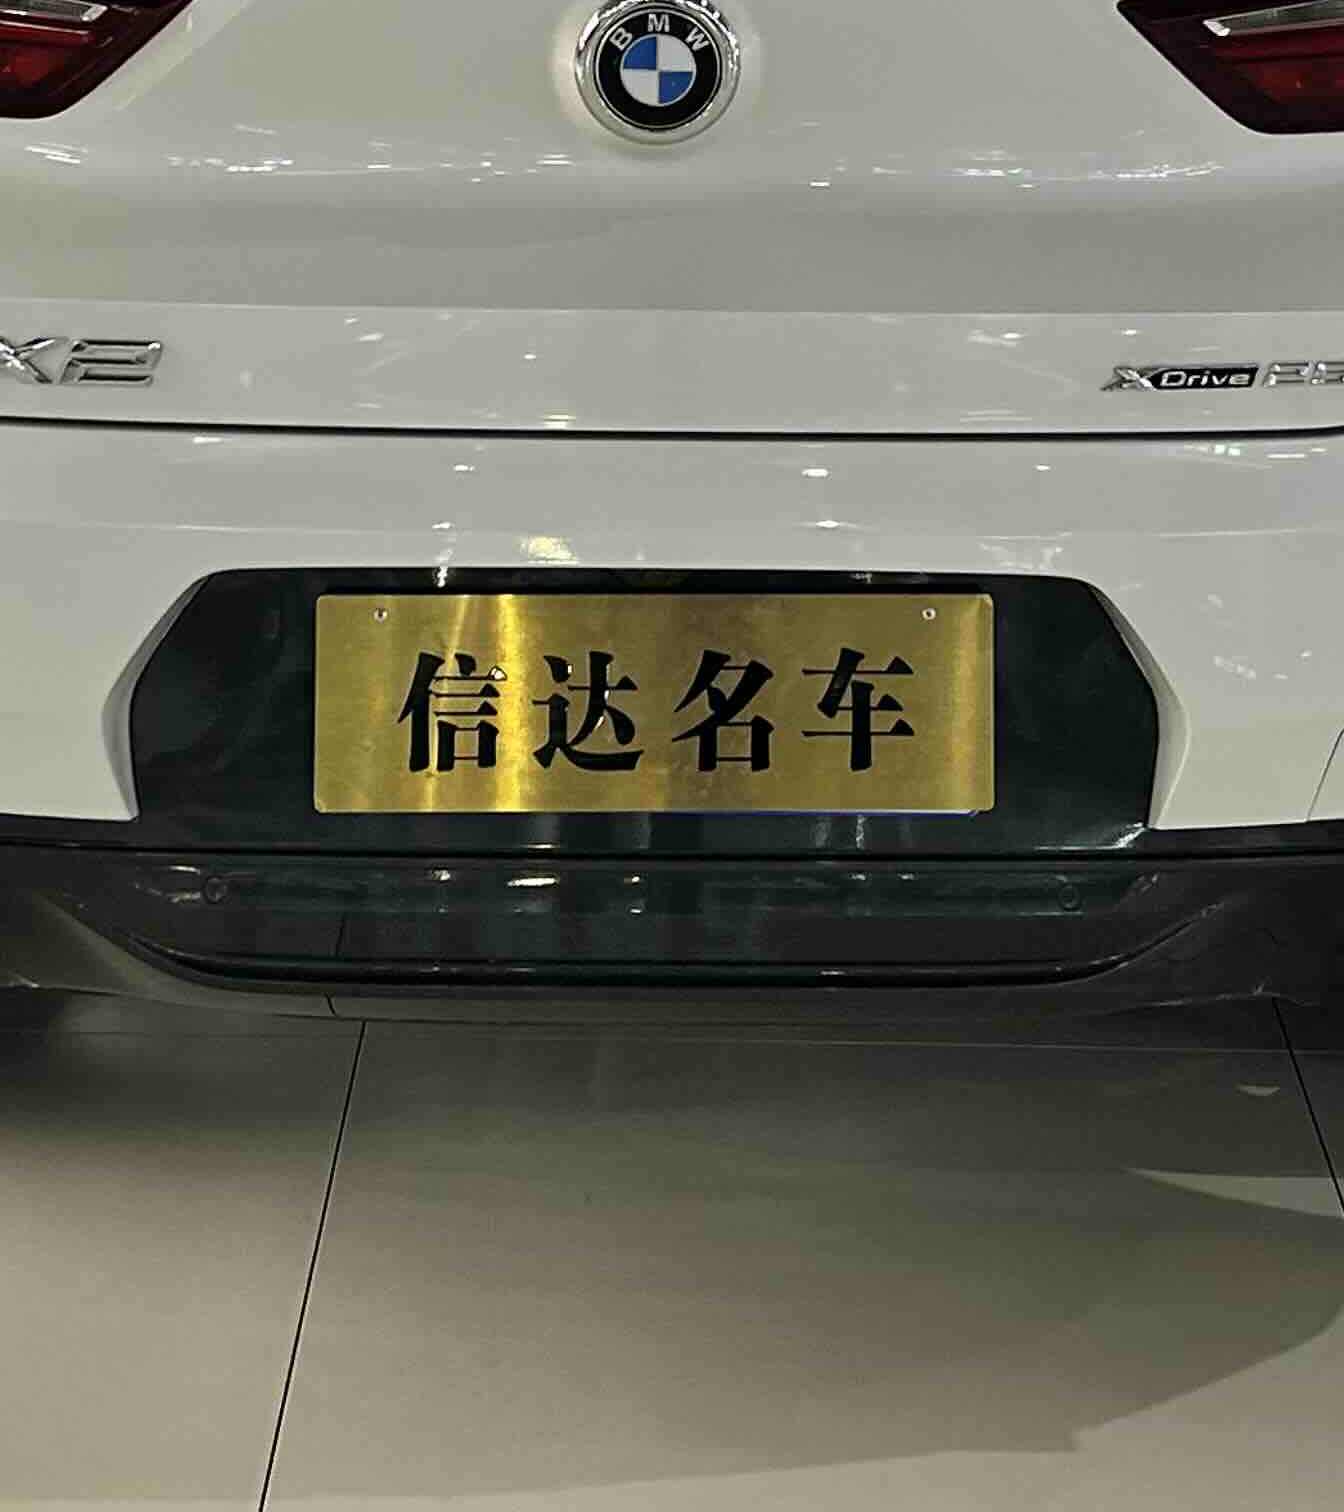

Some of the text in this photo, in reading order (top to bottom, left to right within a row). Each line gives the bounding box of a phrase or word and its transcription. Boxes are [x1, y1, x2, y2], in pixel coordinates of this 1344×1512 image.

[609, 13, 709, 52] BMW
[397, 645, 916, 774] 信达名车
